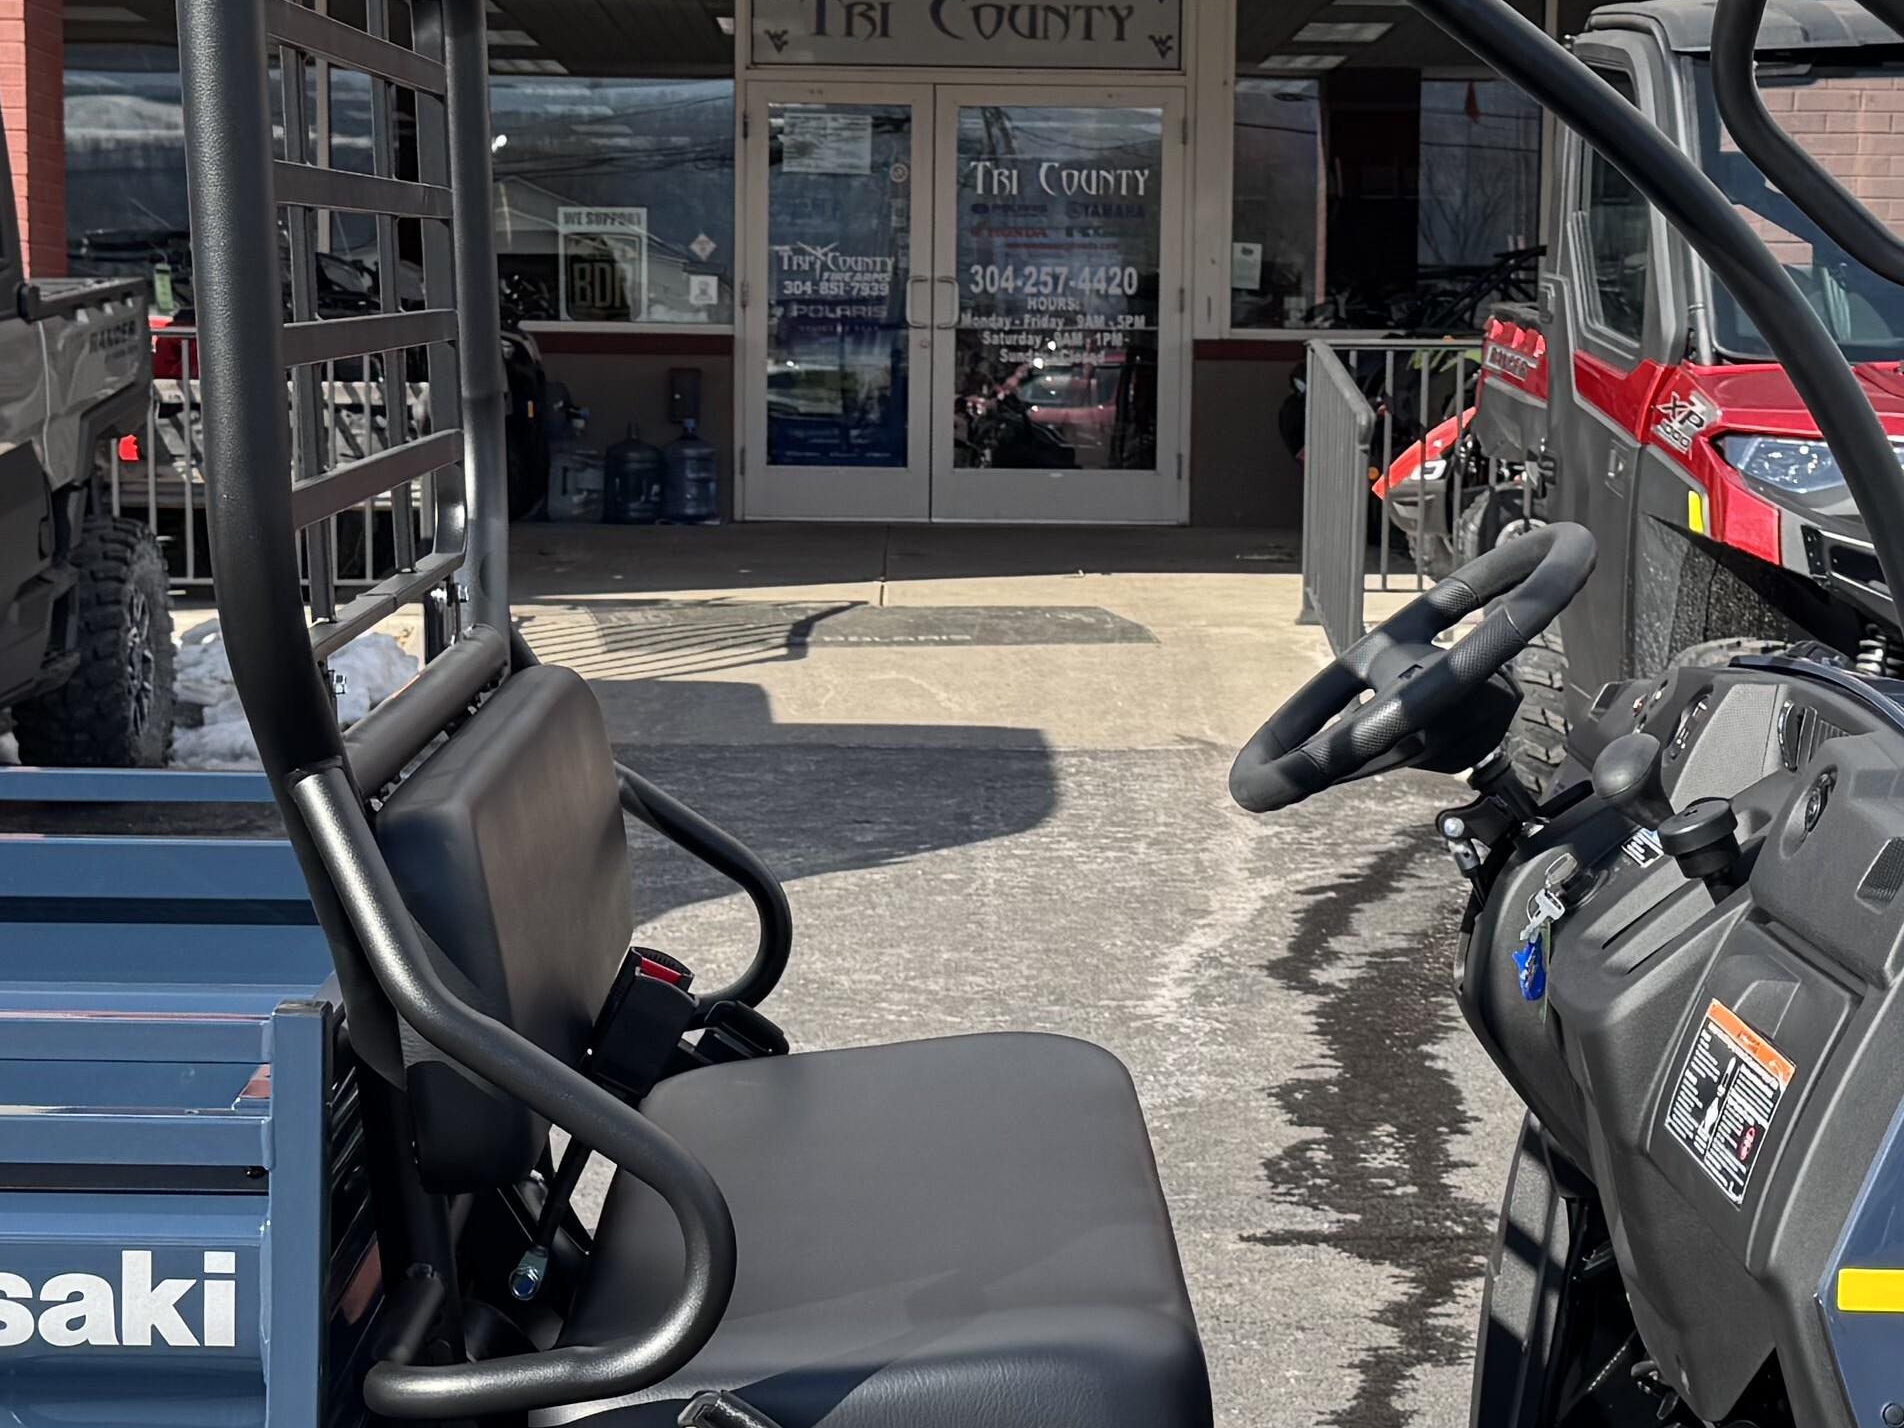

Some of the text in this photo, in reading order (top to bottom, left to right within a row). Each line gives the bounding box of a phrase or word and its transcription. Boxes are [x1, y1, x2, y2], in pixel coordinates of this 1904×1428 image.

[783, 280, 890, 297] 304-851-7939
[970, 265, 1139, 296] 304-257-4420
[789, 305, 888, 319] POLARIS
[961, 309, 1010, 331] Monday
[1023, 313, 1065, 331] Friday
[1075, 314, 1105, 327] 9AM
[1117, 315, 1146, 328] 5PM
[982, 330, 1041, 347] Saturday
[1660, 392, 1706, 430] XP
